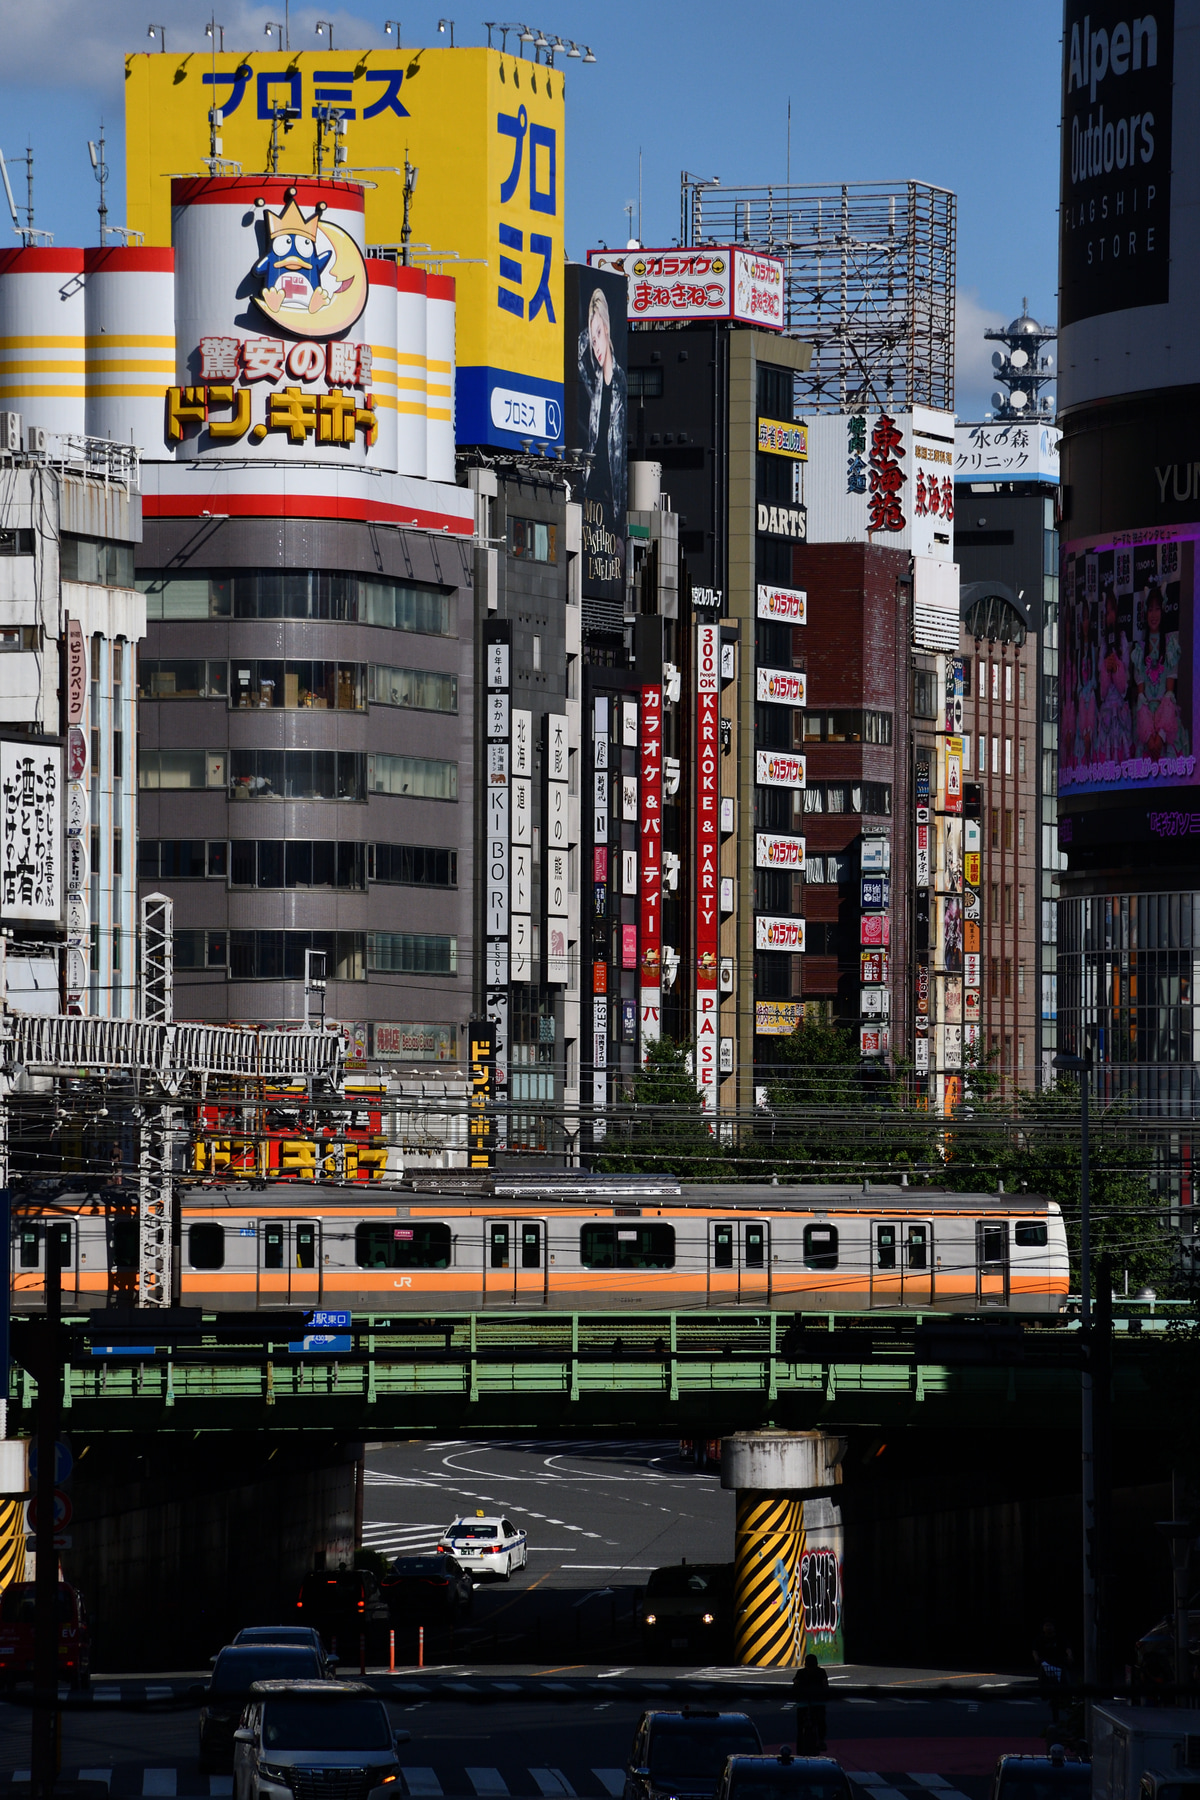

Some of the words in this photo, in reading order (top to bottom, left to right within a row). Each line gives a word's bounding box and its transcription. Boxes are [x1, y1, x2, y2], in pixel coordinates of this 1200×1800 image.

[1067, 14, 1158, 104] Alpen
[202, 64, 411, 120] プロミス
[1071, 104, 1156, 185] Outdoors
[1065, 185, 1156, 232] FLAGSHIP
[1087, 227, 1156, 266] STORE
[645, 257, 712, 277] カラオケ
[754, 261, 777, 285] カラオケ
[632, 281, 725, 312] まねきねこ
[750, 287, 780, 317] まねきねこ
[199, 337, 373, 386] 驚安の殿堂
[504, 398, 536, 429] プロミス
[847, 415, 867, 454] 焼肉
[972, 428, 1029, 449] 水の森
[865, 414, 907, 532] 東海苑
[954, 452, 1029, 471] クリニック
[914, 467, 954, 521] 東海苑
[584, 497, 603, 527] MIO
[758, 504, 807, 538] DARTS
[582, 525, 616, 555] YASHIRO
[773, 592, 800, 616] カラオケ
[702, 628, 714, 671] 300
[494, 647, 503, 685] 6年4組
[699, 671, 716, 679] People
[699, 679, 716, 688] OK
[773, 676, 800, 700] カラオケ
[493, 698, 504, 733] おかか
[701, 694, 715, 811] KARAOKE
[773, 759, 800, 783] カラオケ
[3, 777, 18, 905] だけの店
[773, 842, 800, 866] カラオケ
[491, 792, 504, 931] KIBORI
[918, 850, 928, 873] 吉宗
[702, 844, 715, 926] PARTY
[773, 923, 800, 947] カラオケ
[376, 1026, 401, 1053] 免税店
[394, 1277, 412, 1287] JR
[61, 1629, 76, 1638] EV
